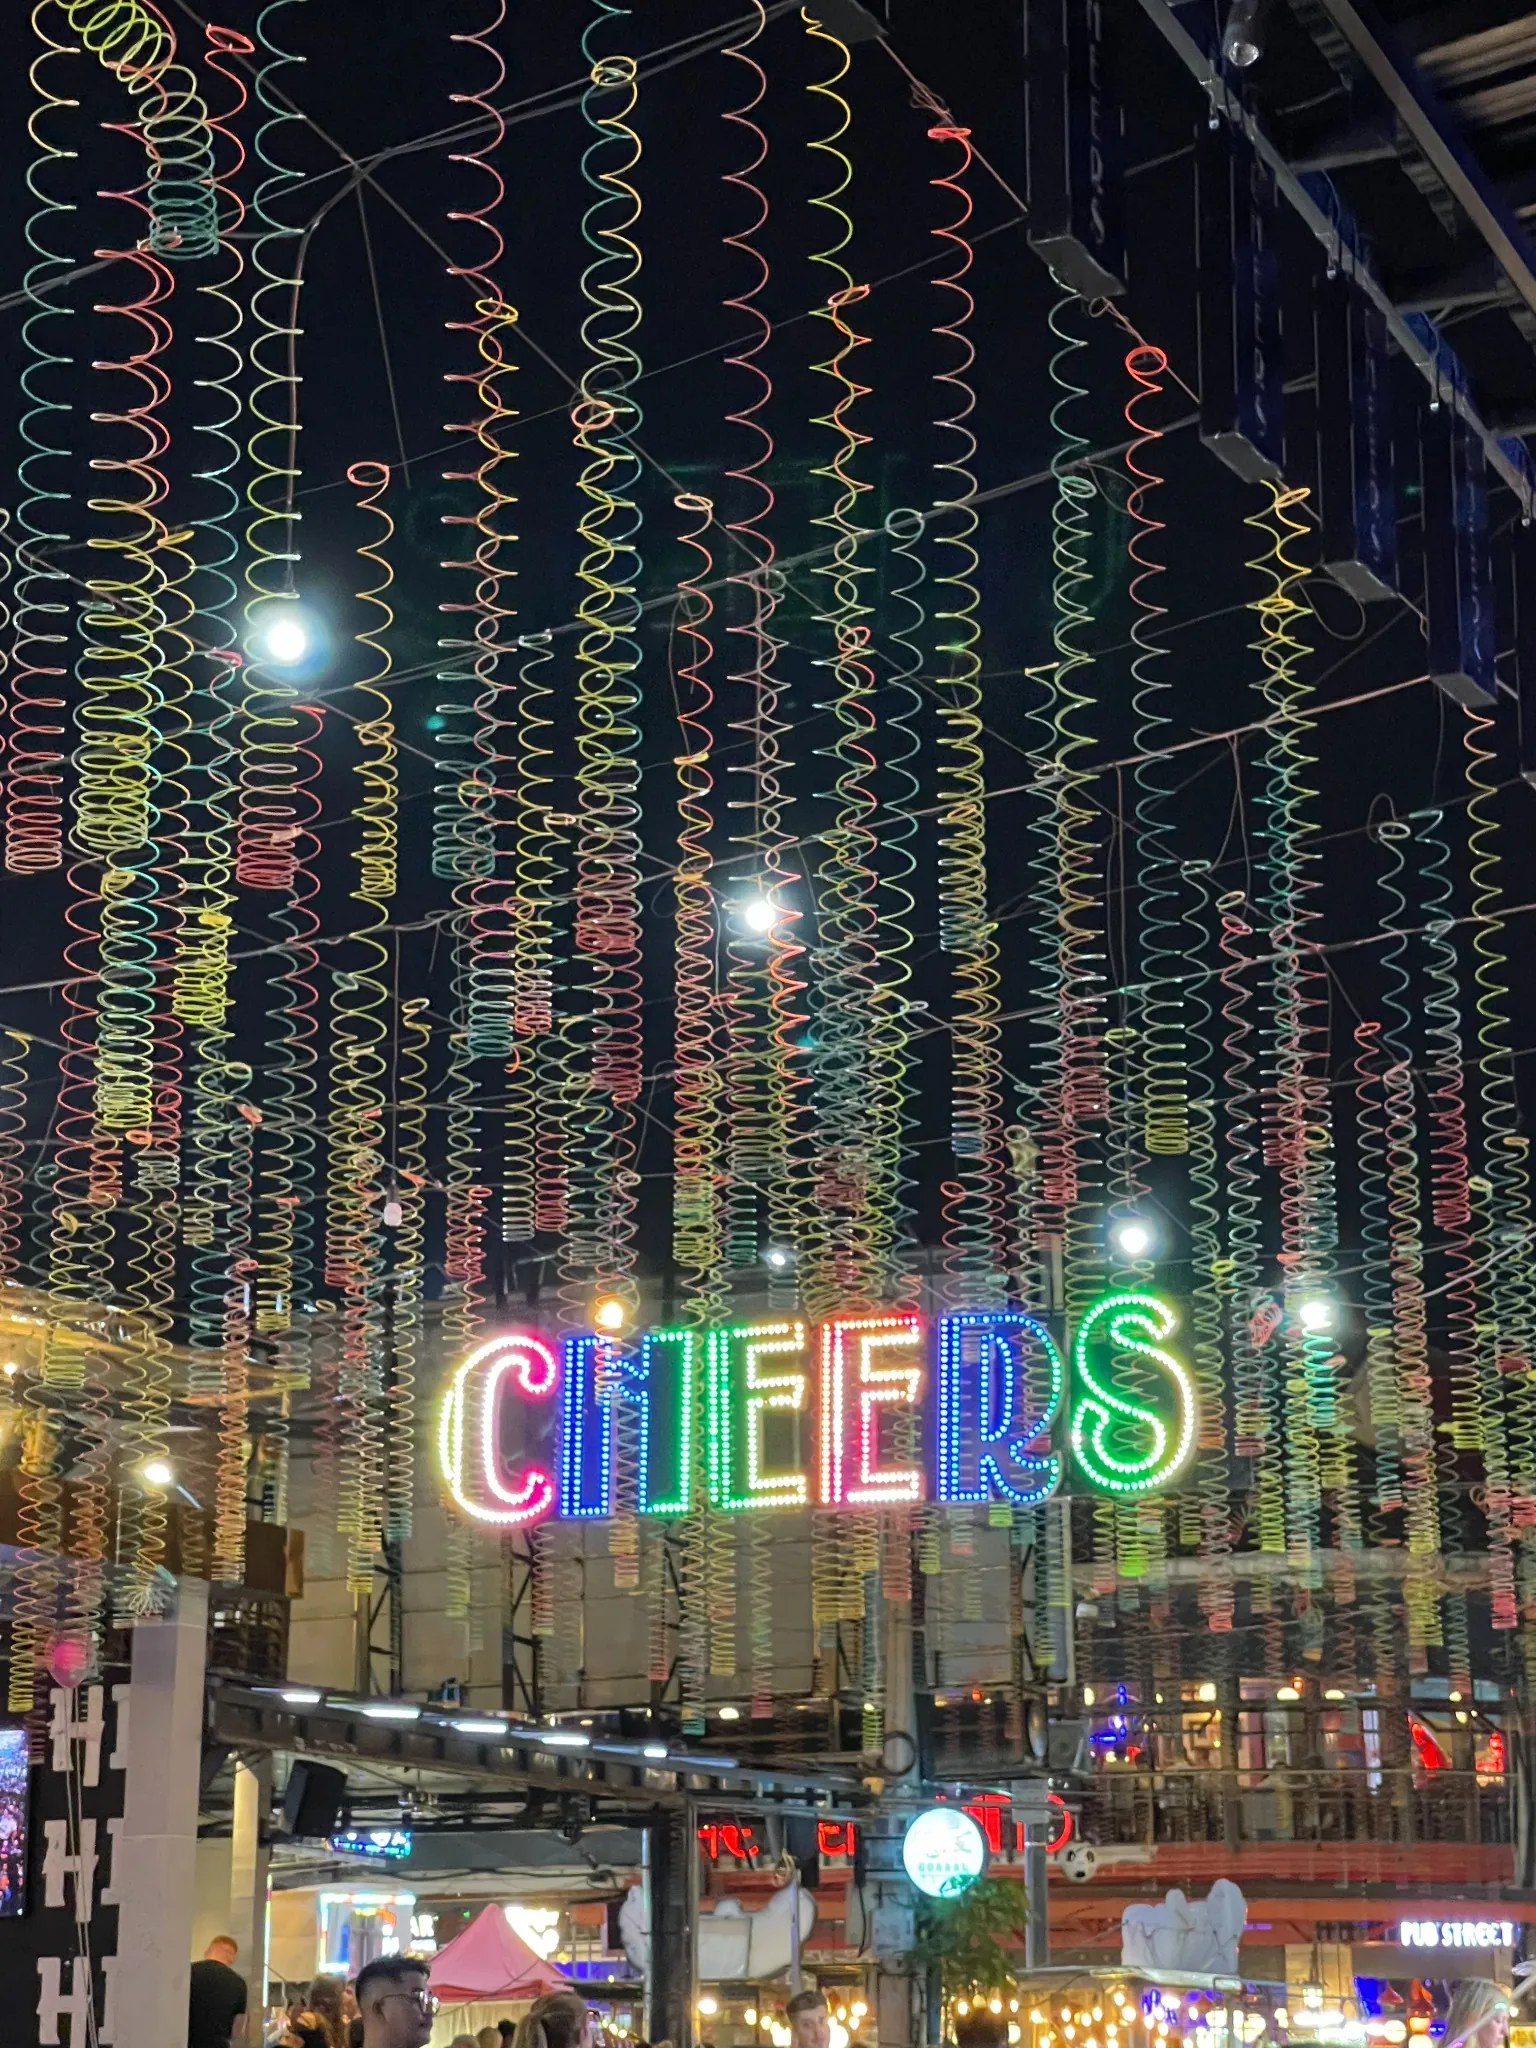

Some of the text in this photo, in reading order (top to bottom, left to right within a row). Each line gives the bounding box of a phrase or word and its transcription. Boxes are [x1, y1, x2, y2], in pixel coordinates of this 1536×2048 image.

[437, 1294, 1195, 1524] CHEERS
[1400, 1921, 1513, 1947] PUB STREET
